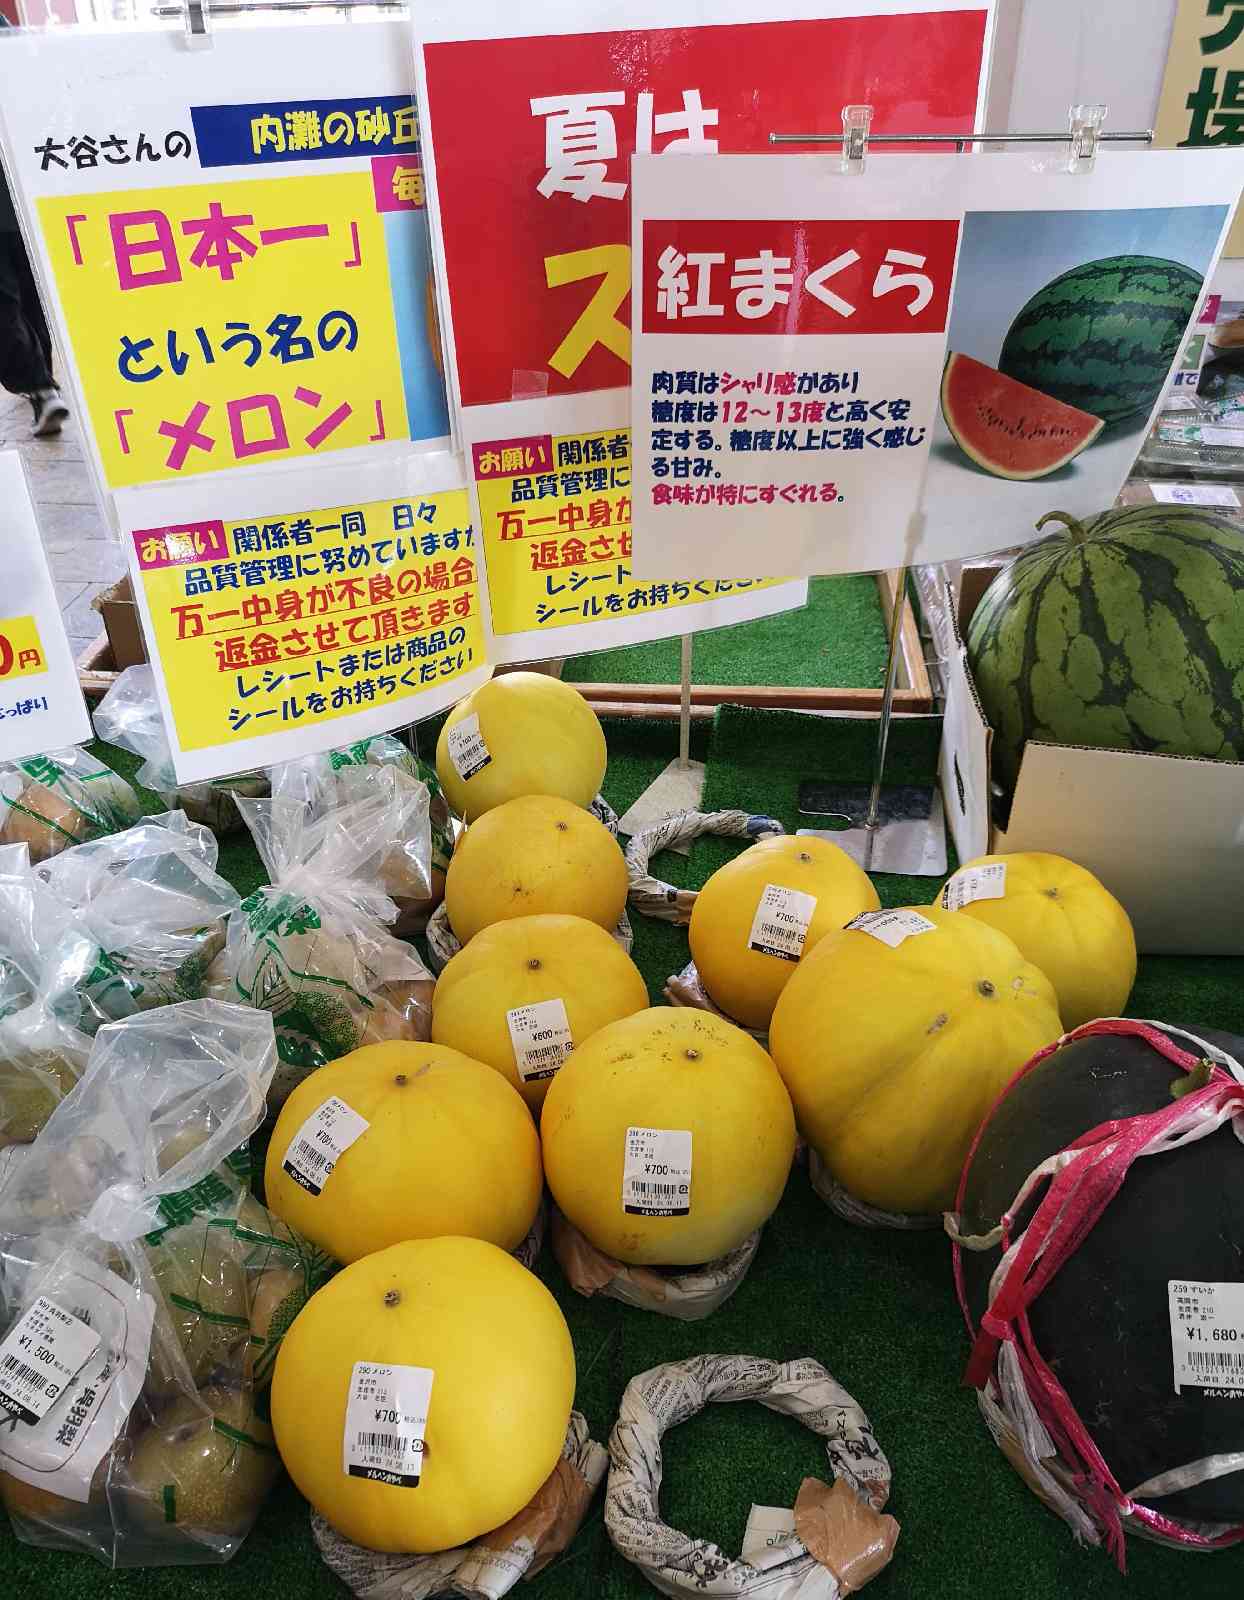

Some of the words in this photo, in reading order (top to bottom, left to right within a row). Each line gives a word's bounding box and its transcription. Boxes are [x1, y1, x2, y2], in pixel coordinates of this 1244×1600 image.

[34, 131, 191, 171] 大谷さんの
[530, 89, 719, 202] 夏は
[66, 202, 362, 291] 「日本一」
[656, 245, 934, 320] 紅まくら
[118, 310, 359, 383] という名の
[651, 371, 860, 395] 肉質はシャリ感があり
[114, 386, 386, 471] 「メロン」
[651, 426, 926, 452] 定する。糖度以上に強く感じ
[478, 445, 545, 474] お願い
[511, 466, 631, 503] 品質管理に
[651, 456, 722, 479] る甘み。
[651, 482, 844, 506] 食味が特にすぐれる。
[140, 530, 219, 563] お願い
[232, 510, 367, 555] 関係者一同
[392, 502, 437, 531] 日々
[170, 557, 474, 639] 万一中身が不良の場合
[545, 564, 632, 596] レシート
[213, 592, 474, 672] 返金させて頂きます
[237, 626, 466, 699] レシートまたは商品の
[227, 648, 473, 731] シールをお持ちください
[644, 1163, 669, 1176] ¥700
